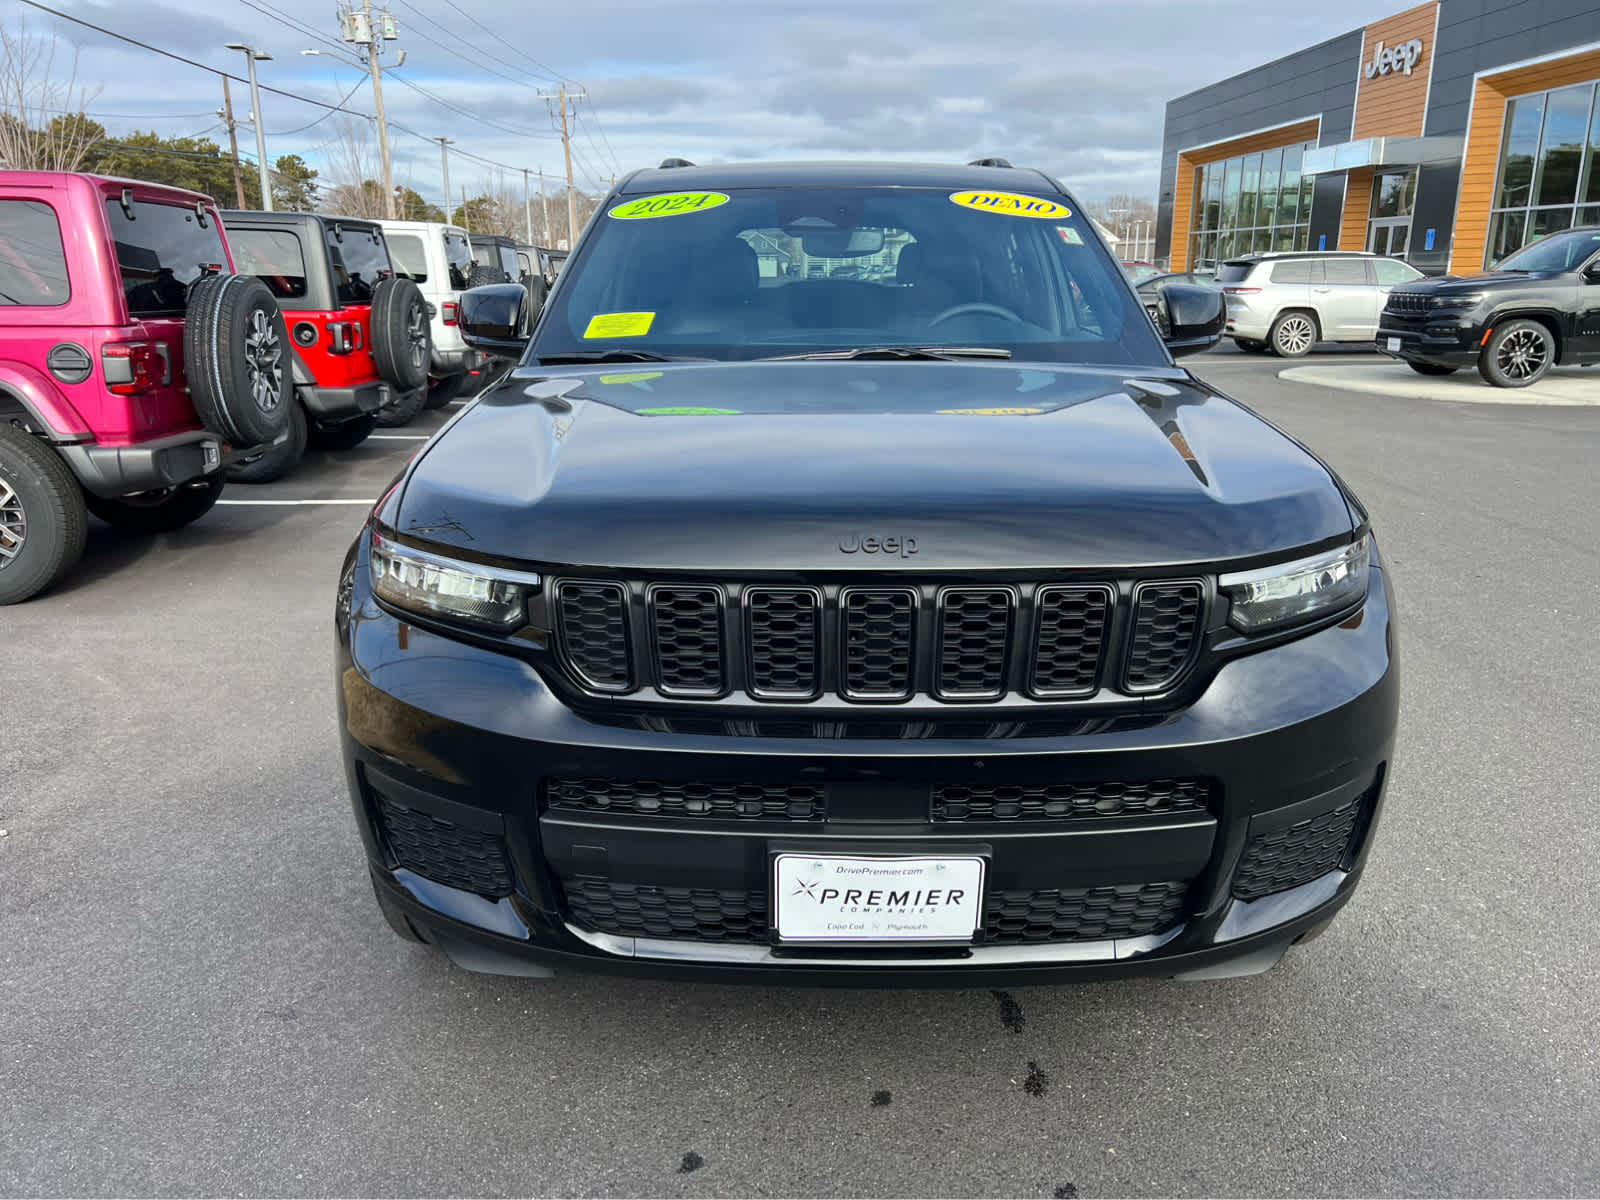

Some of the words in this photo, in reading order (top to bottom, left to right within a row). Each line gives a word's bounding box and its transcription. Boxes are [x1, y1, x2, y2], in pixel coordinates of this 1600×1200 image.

[1365, 38, 1422, 78] Jeep
[627, 194, 709, 215] 2024
[969, 195, 1057, 213] DEMO
[839, 535, 919, 559] Jeep
[820, 889, 965, 906] PREMIER
